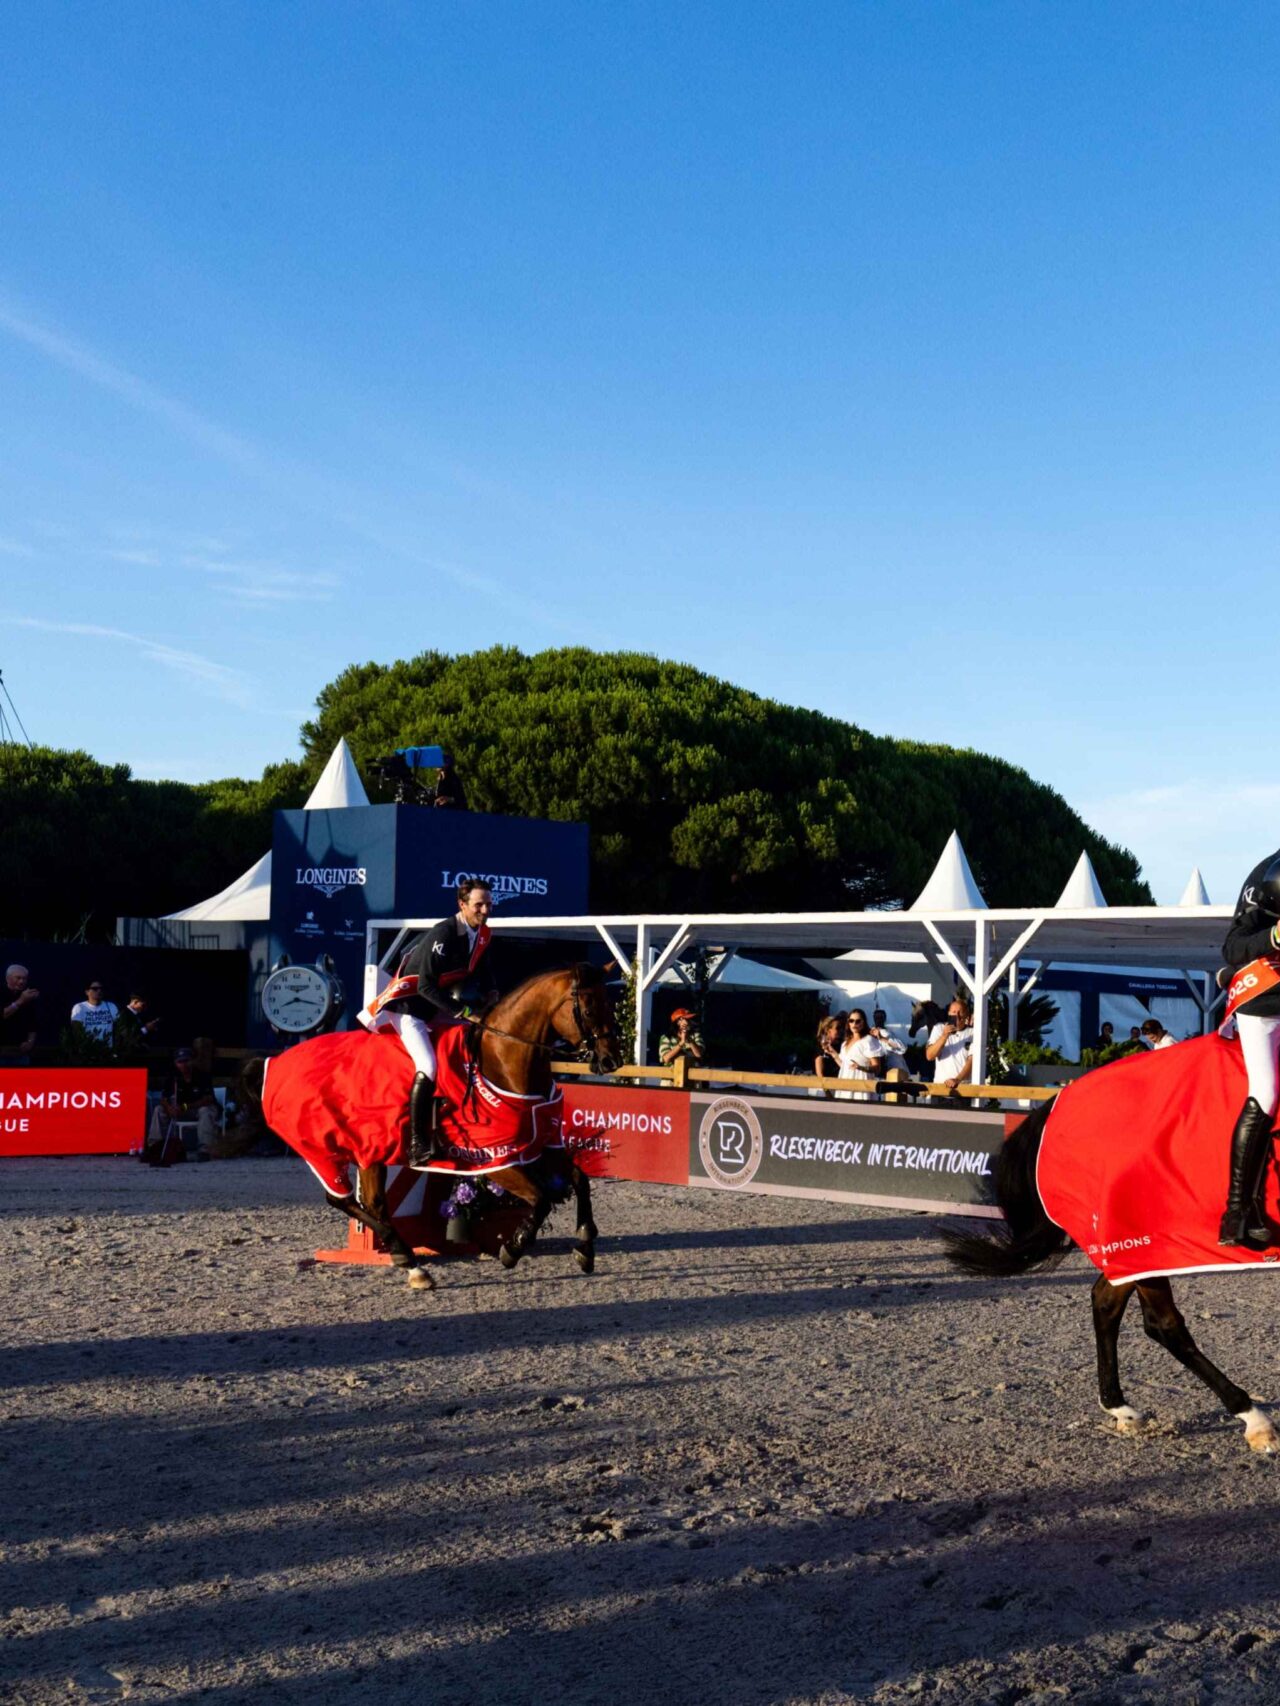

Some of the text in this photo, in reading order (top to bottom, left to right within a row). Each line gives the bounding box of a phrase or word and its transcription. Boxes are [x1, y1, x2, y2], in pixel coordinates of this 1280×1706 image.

[296, 868, 366, 885] LONGINES
[572, 1109, 671, 1134] CHAMPIONS
[770, 1134, 992, 1176] RIESENBECK INTERNATIONAL
